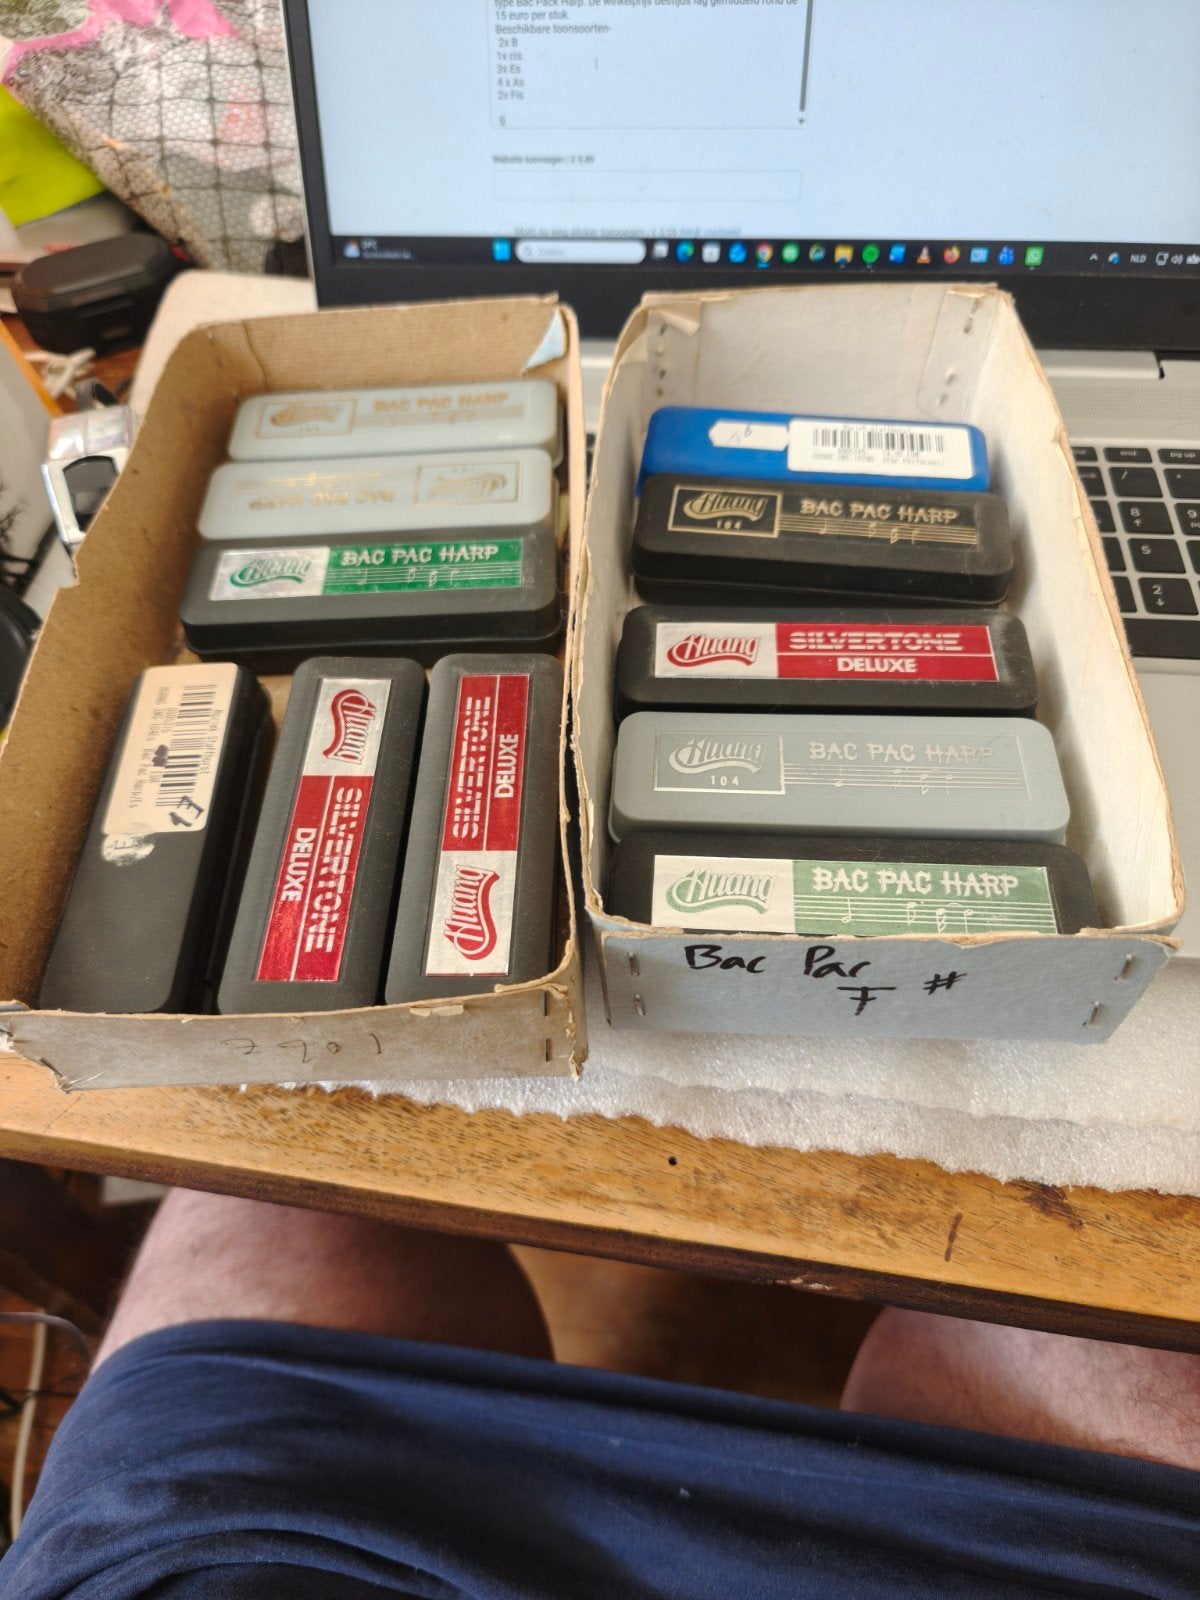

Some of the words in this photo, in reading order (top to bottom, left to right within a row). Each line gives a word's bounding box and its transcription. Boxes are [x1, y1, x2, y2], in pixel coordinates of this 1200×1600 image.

[495, 11, 506, 20] 15
[531, 12, 546, 23] per
[495, 24, 551, 34] Beschikbare
[1130, 254, 1147, 263] NLD
[684, 490, 769, 521] Huang
[800, 498, 843, 517] BAC
[850, 501, 890, 520] PAC
[896, 503, 959, 524] HARP
[1129, 507, 1141, 517] 8
[1187, 509, 1197, 519] 9
[715, 519, 742, 531] 104
[341, 549, 385, 567] BAC
[391, 547, 432, 565] PAC
[440, 544, 499, 562] HARP
[1141, 544, 1151, 555] 5
[1152, 584, 1163, 595] 2
[667, 633, 761, 668] Huang
[789, 631, 964, 652] SILVERTONE
[836, 656, 918, 674] DELUXE
[322, 688, 378, 766] Huang
[451, 696, 491, 839] SILVERTONE
[494, 733, 519, 798] DELUXE
[669, 737, 768, 774] Huang
[808, 741, 858, 762] BAC
[866, 742, 916, 764] PAC
[924, 743, 994, 765] HARP
[709, 774, 740, 788] 104
[280, 827, 317, 902] DELUXE
[305, 786, 363, 954] SILVERTONE
[665, 867, 776, 915] Huang
[812, 867, 870, 893] BAC
[876, 869, 933, 895] PAC
[940, 871, 1020, 900] HARP
[442, 864, 500, 961] Huang
[684, 944, 769, 975] Bac
